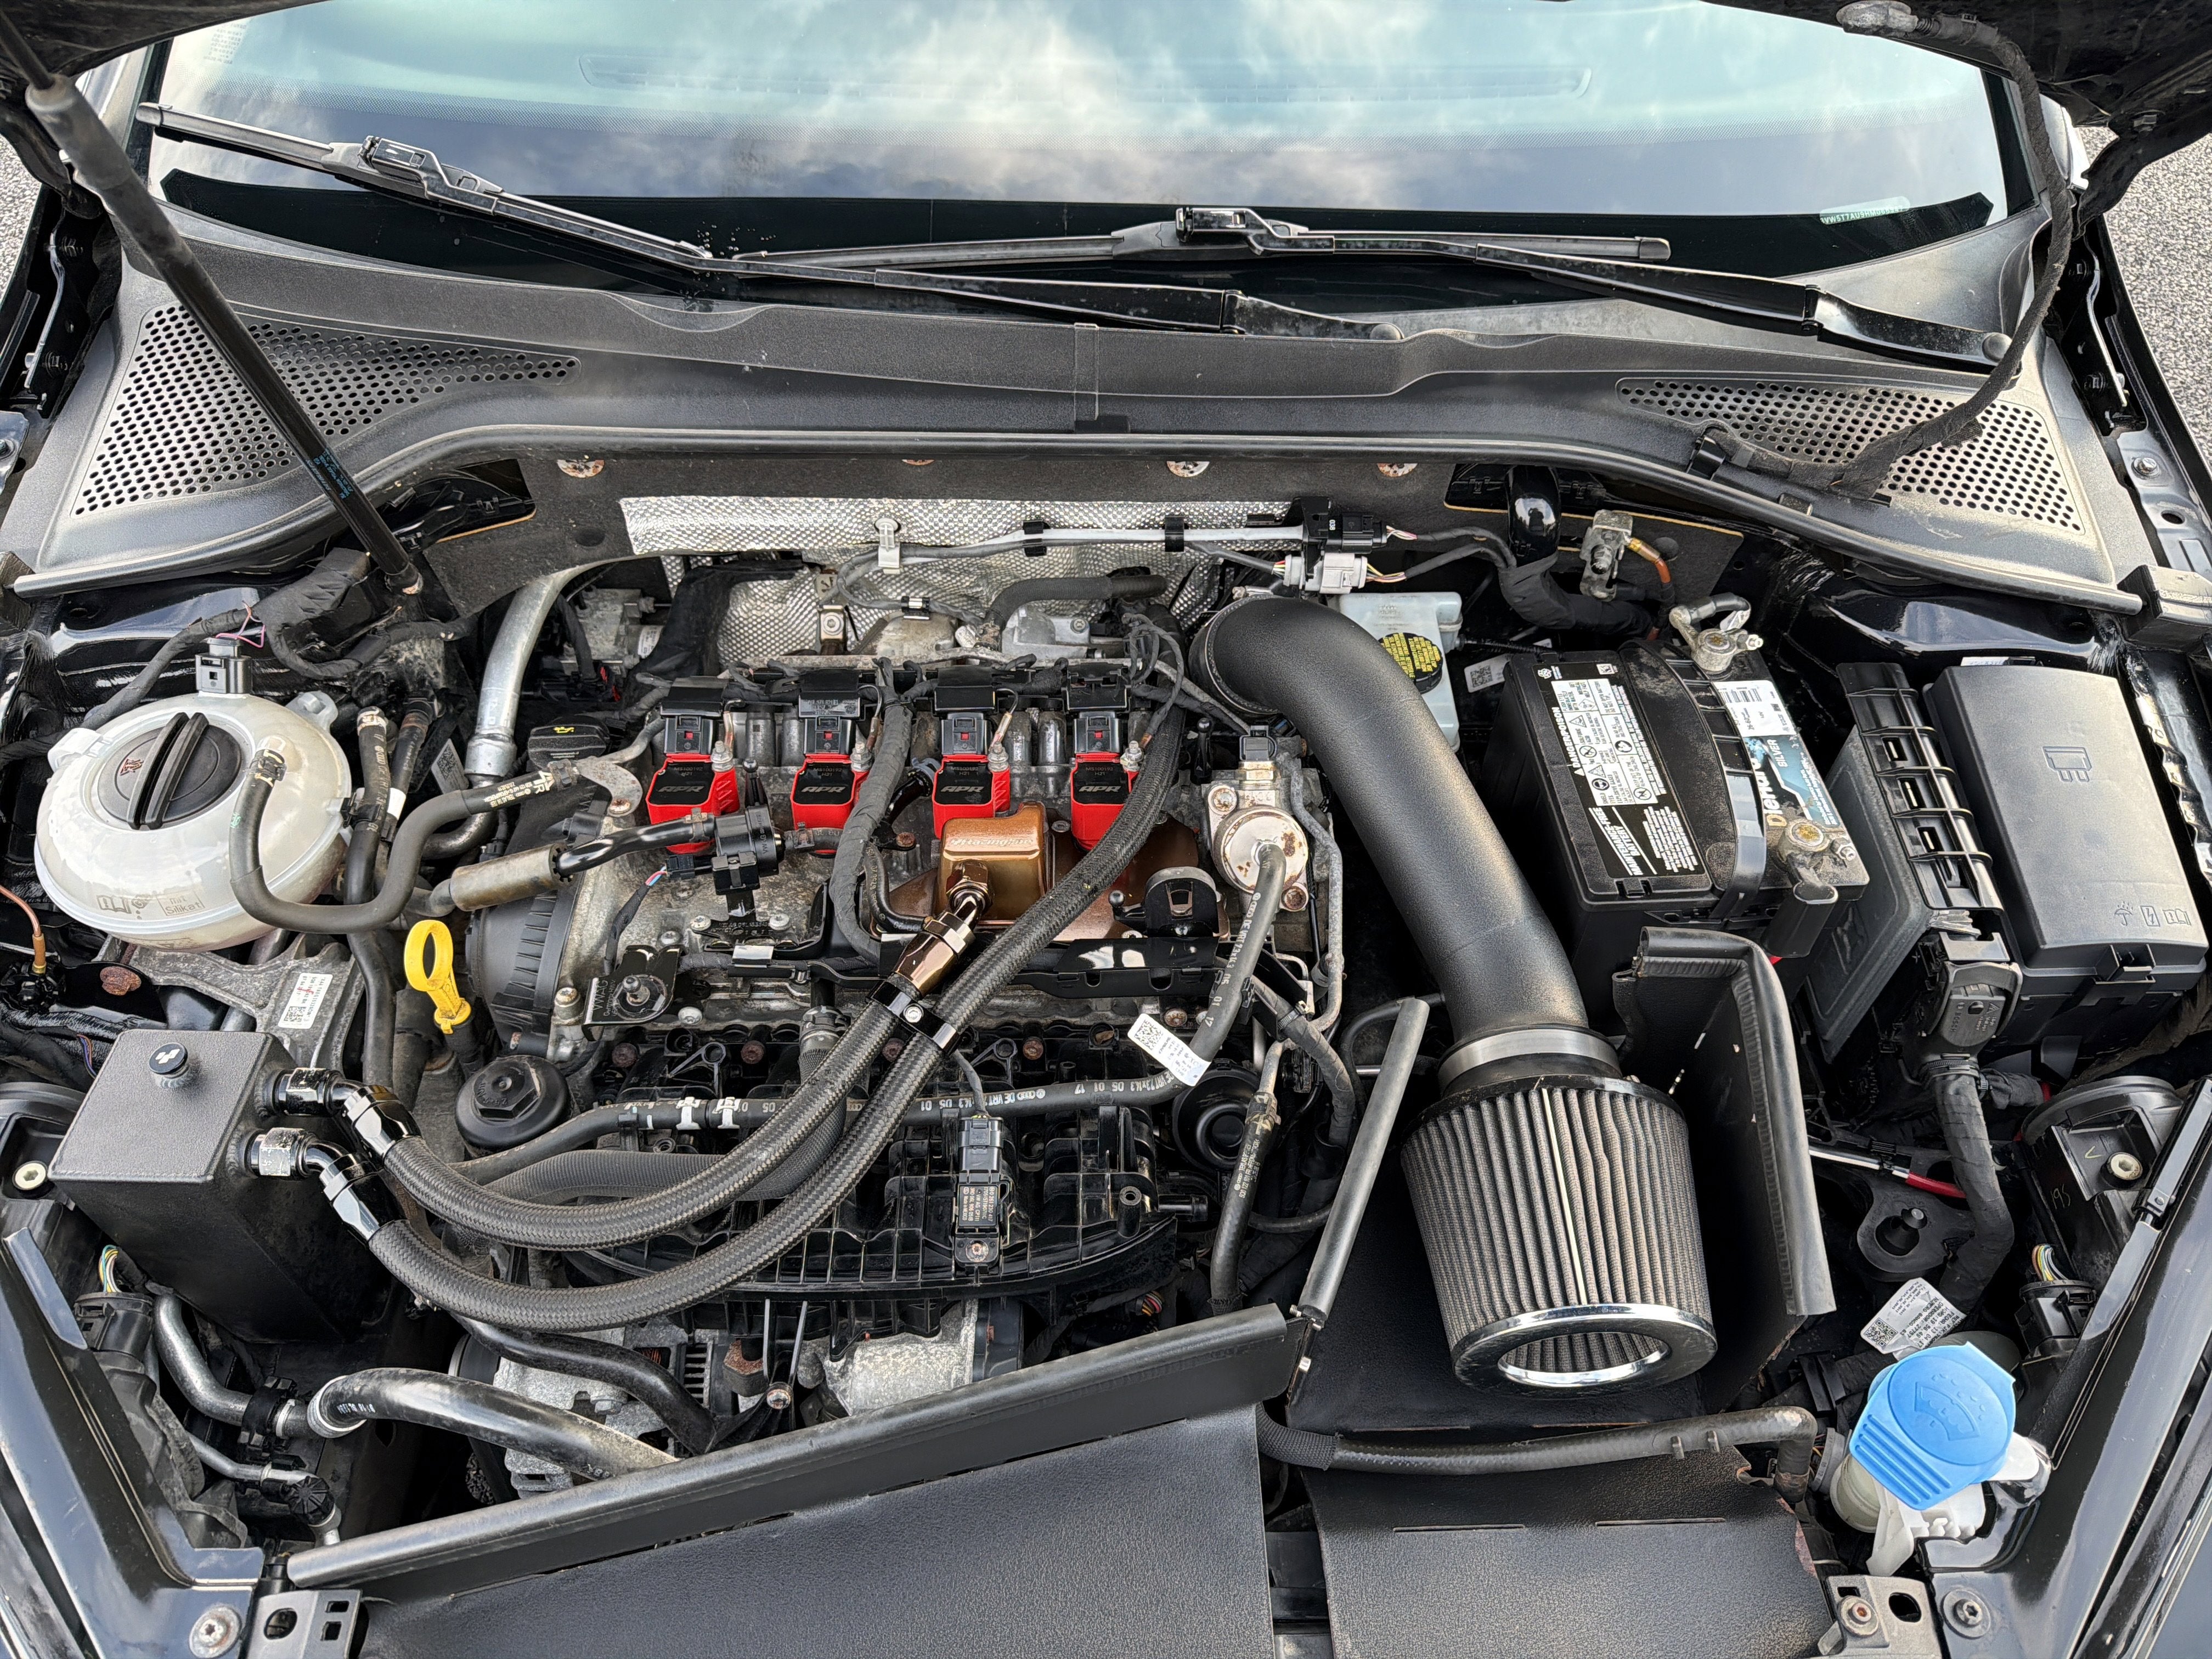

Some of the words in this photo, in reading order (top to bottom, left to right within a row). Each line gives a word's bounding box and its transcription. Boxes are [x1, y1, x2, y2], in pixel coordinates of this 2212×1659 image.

[1551, 706, 1581, 768] DANGER/POISON
[1766, 738, 1788, 768] SILVER
[1592, 807, 1643, 875] MAINTENANCE-FREE
[1613, 825, 1640, 856] BATTERY
[763, 844, 768, 854] VW
[169, 896, 187, 905] mit
[165, 901, 202, 914] Silikat
[1242, 919, 1252, 929] DE
[1234, 930, 1249, 944] VRT
[596, 980, 608, 994] AG
[592, 994, 605, 1010] VW
[1211, 996, 1223, 1007] 01
[1205, 1015, 1214, 1028] 17
[1950, 1012, 1962, 1032] BOSCH
[1074, 1084, 1086, 1094] 17
[1094, 1082, 1105, 1092] 01
[1111, 1081, 1125, 1092] 05
[939, 1099, 952, 1110] 05
[989, 1094, 1003, 1106] VRT
[1005, 1093, 1015, 1104] DE
[921, 1100, 932, 1111] 01
